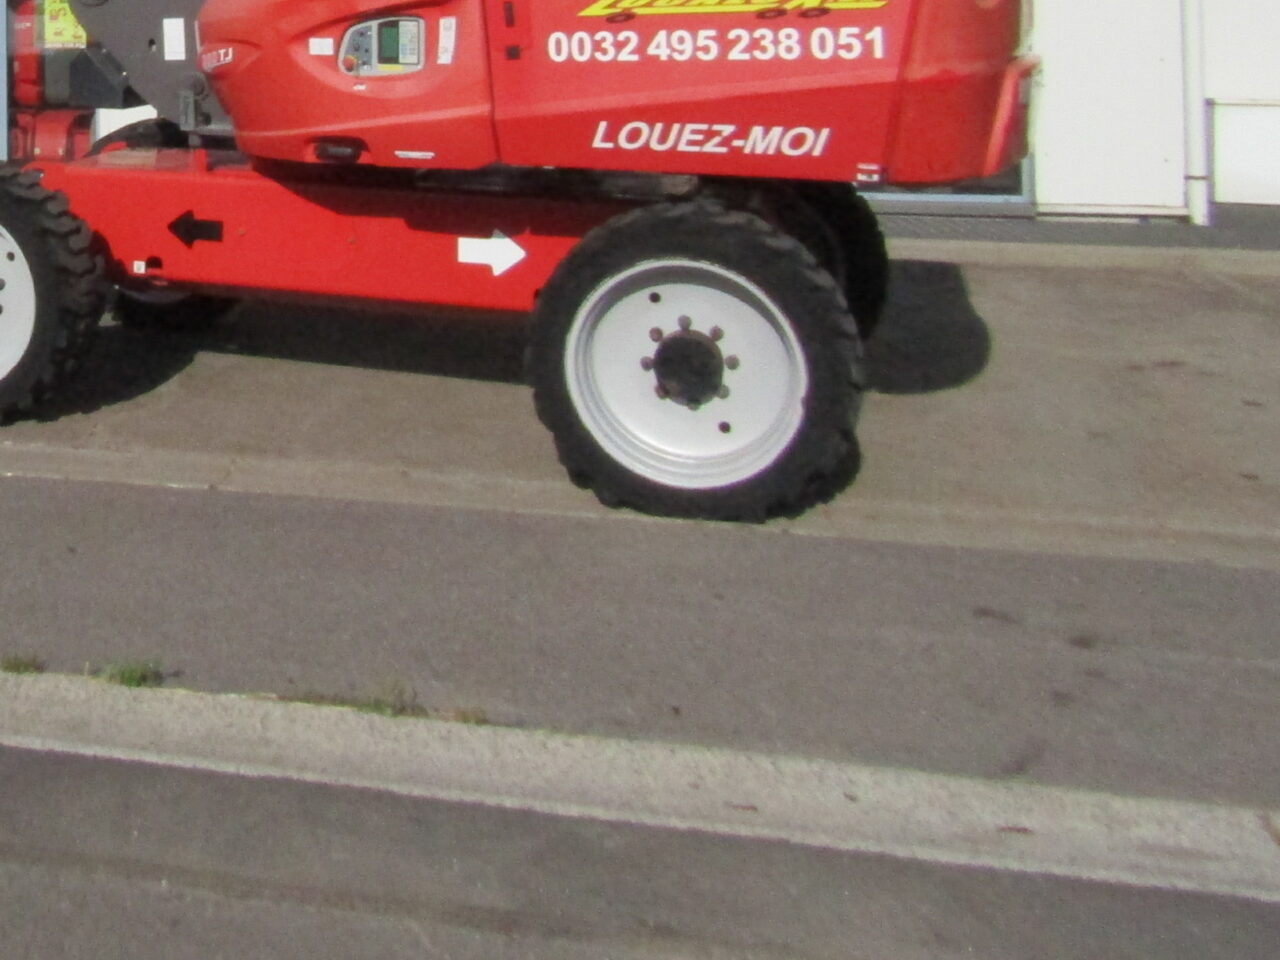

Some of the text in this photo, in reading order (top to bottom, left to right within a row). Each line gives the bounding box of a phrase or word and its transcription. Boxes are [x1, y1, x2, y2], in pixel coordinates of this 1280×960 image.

[547, 25, 885, 63] 0032 495 238 051
[591, 120, 831, 157] LOUEZ-MOI
